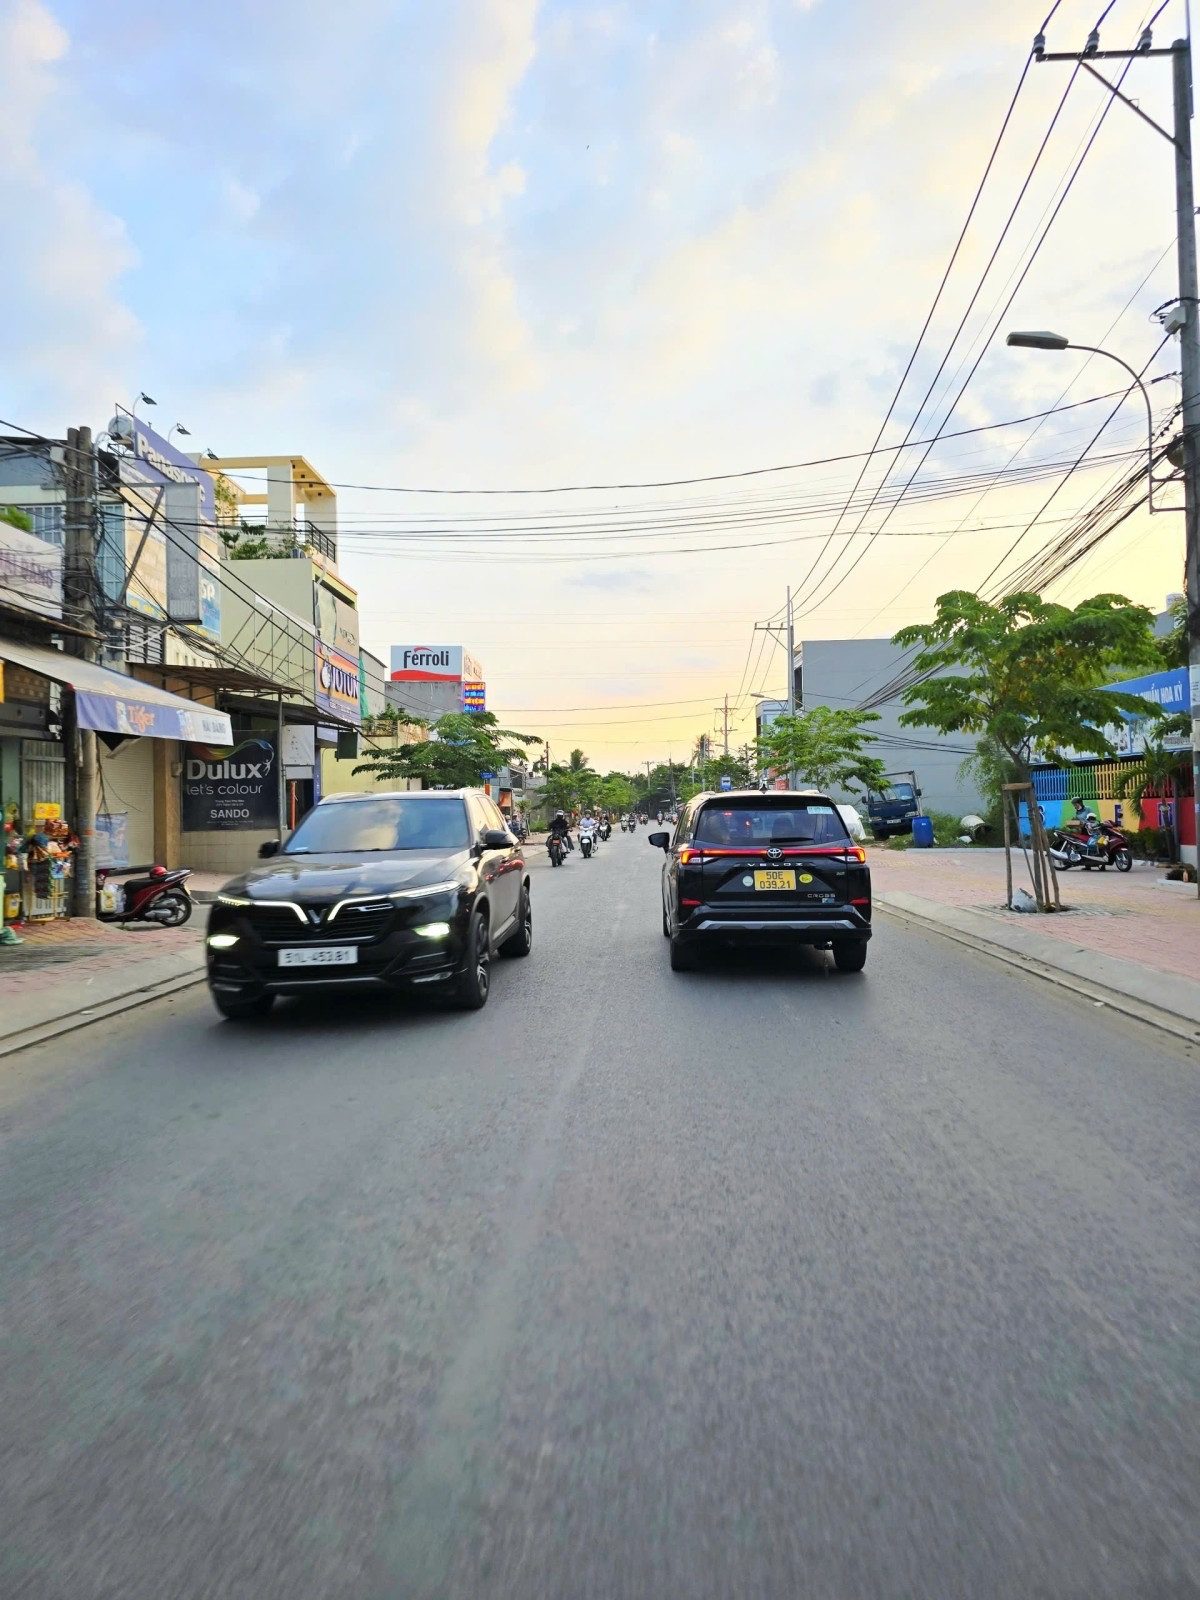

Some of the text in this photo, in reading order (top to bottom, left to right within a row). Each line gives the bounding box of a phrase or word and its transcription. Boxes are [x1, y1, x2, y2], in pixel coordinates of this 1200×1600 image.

[403, 650, 450, 669] Ferroli
[187, 760, 263, 779] Dulux
[186, 783, 263, 795] let's colour
[210, 809, 250, 818] SANDO
[766, 871, 784, 880] 50E
